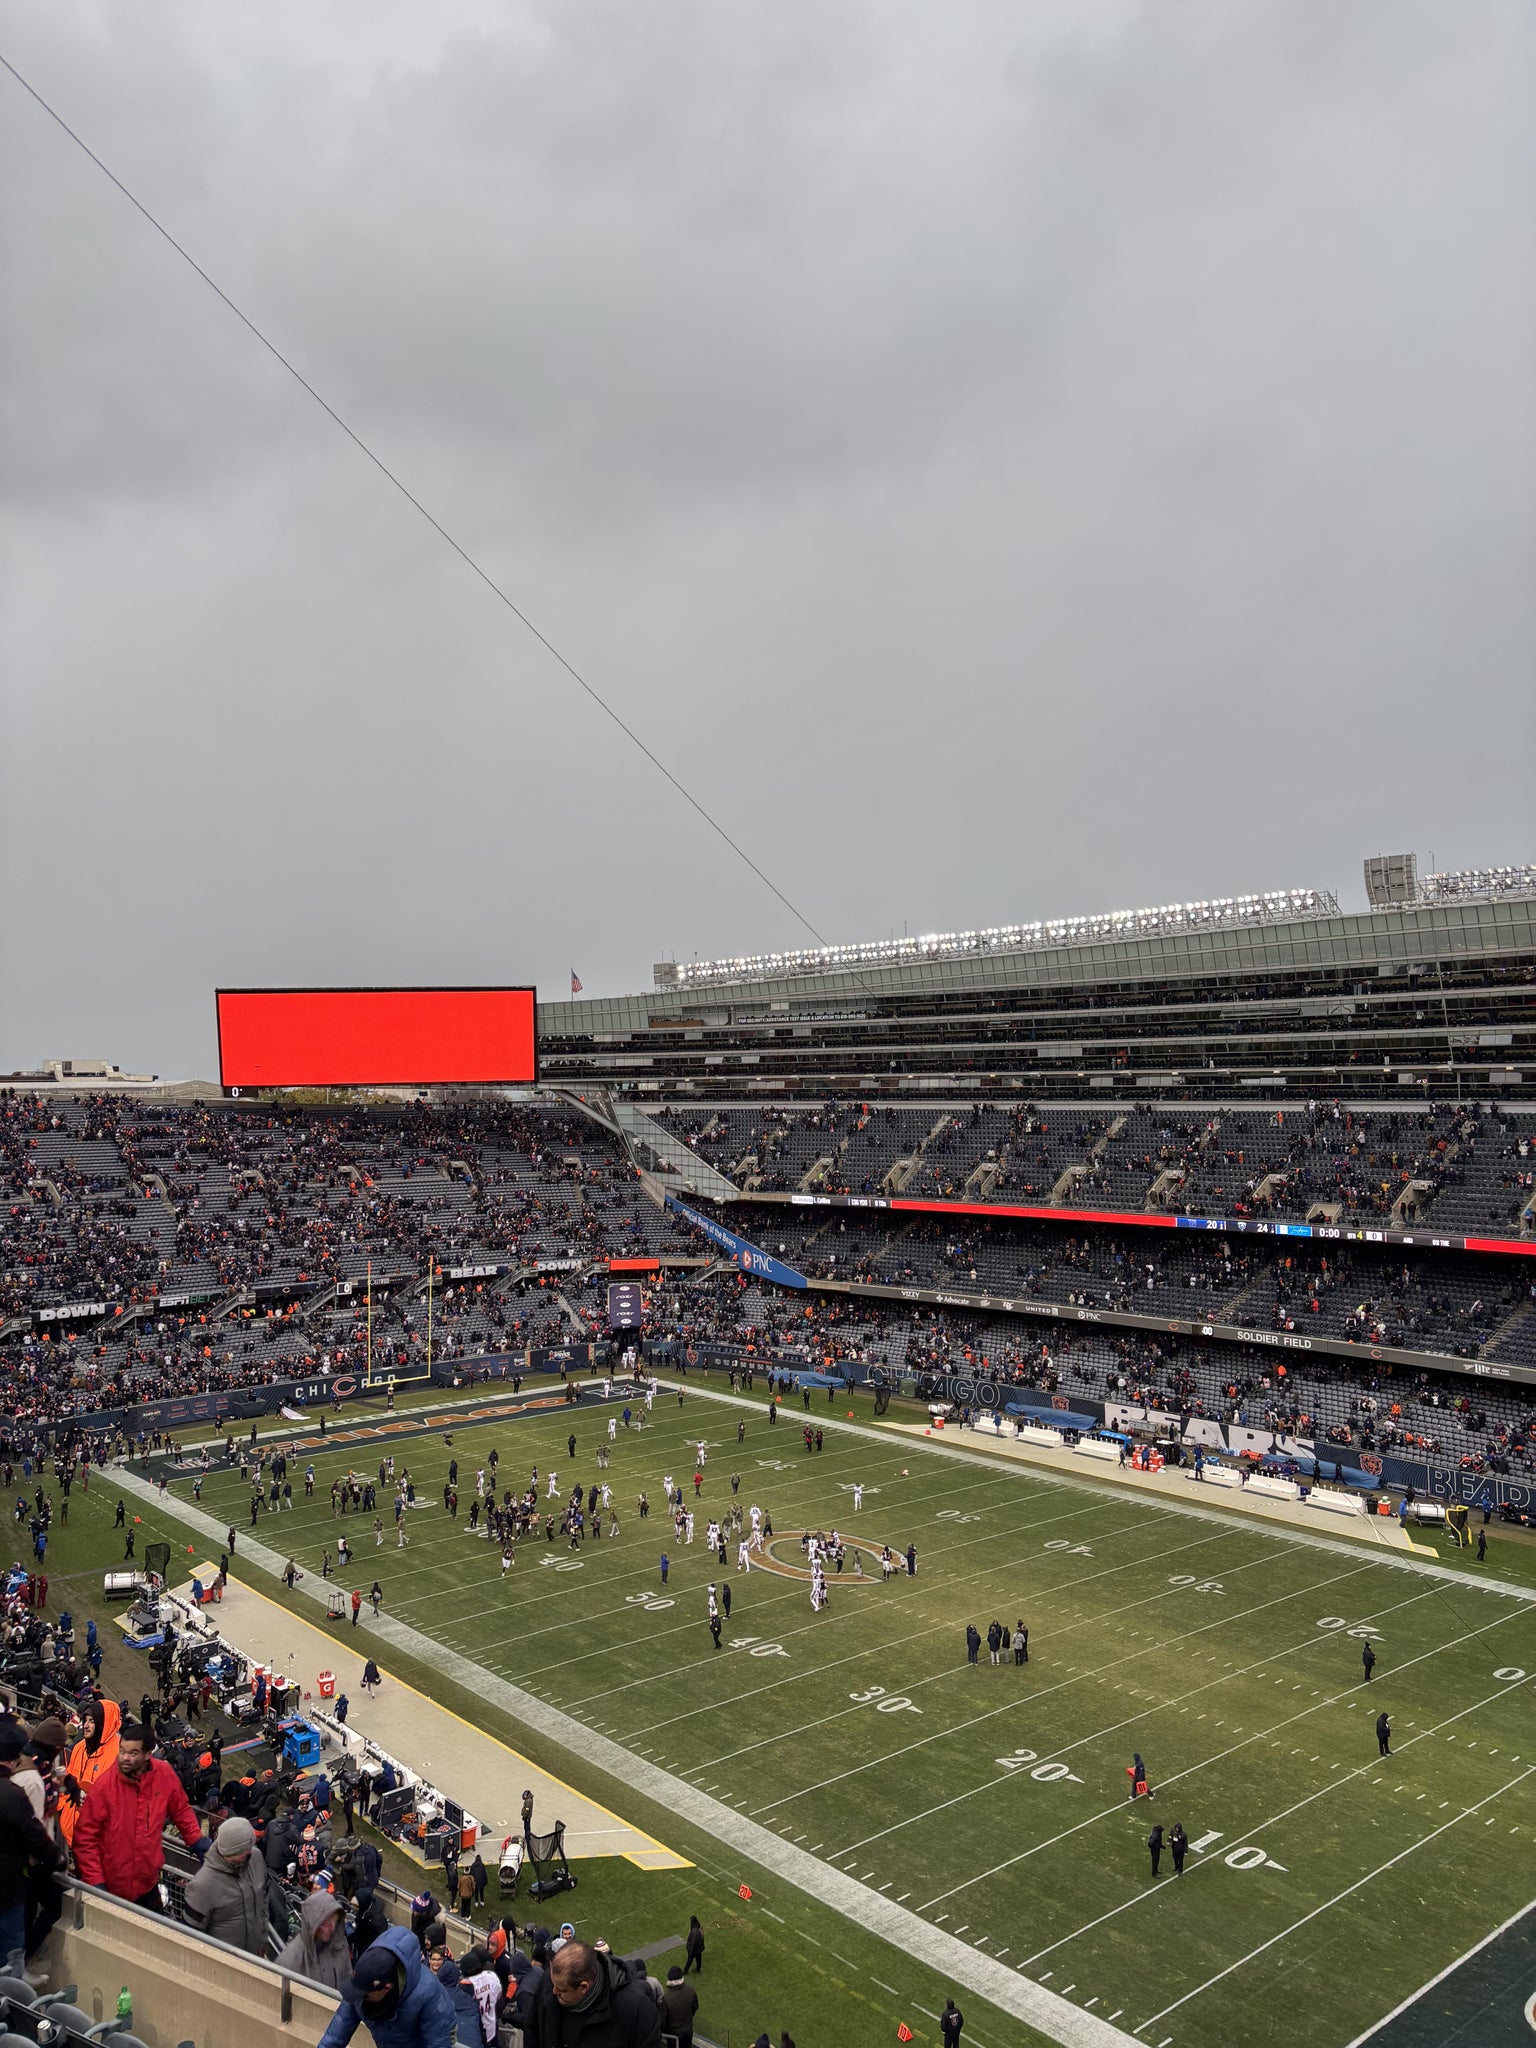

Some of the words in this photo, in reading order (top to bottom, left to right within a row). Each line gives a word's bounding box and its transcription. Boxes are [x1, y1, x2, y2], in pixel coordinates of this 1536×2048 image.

[1206, 1220, 1217, 1229] 20
[1257, 1223, 1268, 1233] 24
[1319, 1227, 1340, 1238] 0:00
[1356, 1231, 1363, 1240] 4
[537, 1261, 581, 1271] DOWN
[752, 1253, 773, 1273] PNC
[450, 1265, 498, 1278] BEAR
[160, 1295, 189, 1307] ESPN
[901, 1290, 920, 1298] VIZZY
[944, 1296, 970, 1305] Advocate
[40, 1304, 106, 1321] DOWN
[1025, 1306, 1050, 1314] UNITED
[1085, 1311, 1101, 1321] PNC
[1237, 1331, 1279, 1345] SOLDIER
[1283, 1337, 1312, 1349] FIELD
[935, 1509, 981, 1524] 50
[1043, 1539, 1093, 1555] 40
[538, 1555, 585, 1572] 40
[1168, 1574, 1224, 1593] 30
[625, 1591, 676, 1611] 50
[1316, 1616, 1381, 1638] 20
[728, 1636, 783, 1658] 40
[323, 1684, 331, 1692] G
[849, 1685, 913, 1713] 30
[994, 1748, 1070, 1783] 20
[1187, 1829, 1267, 1870] 10
